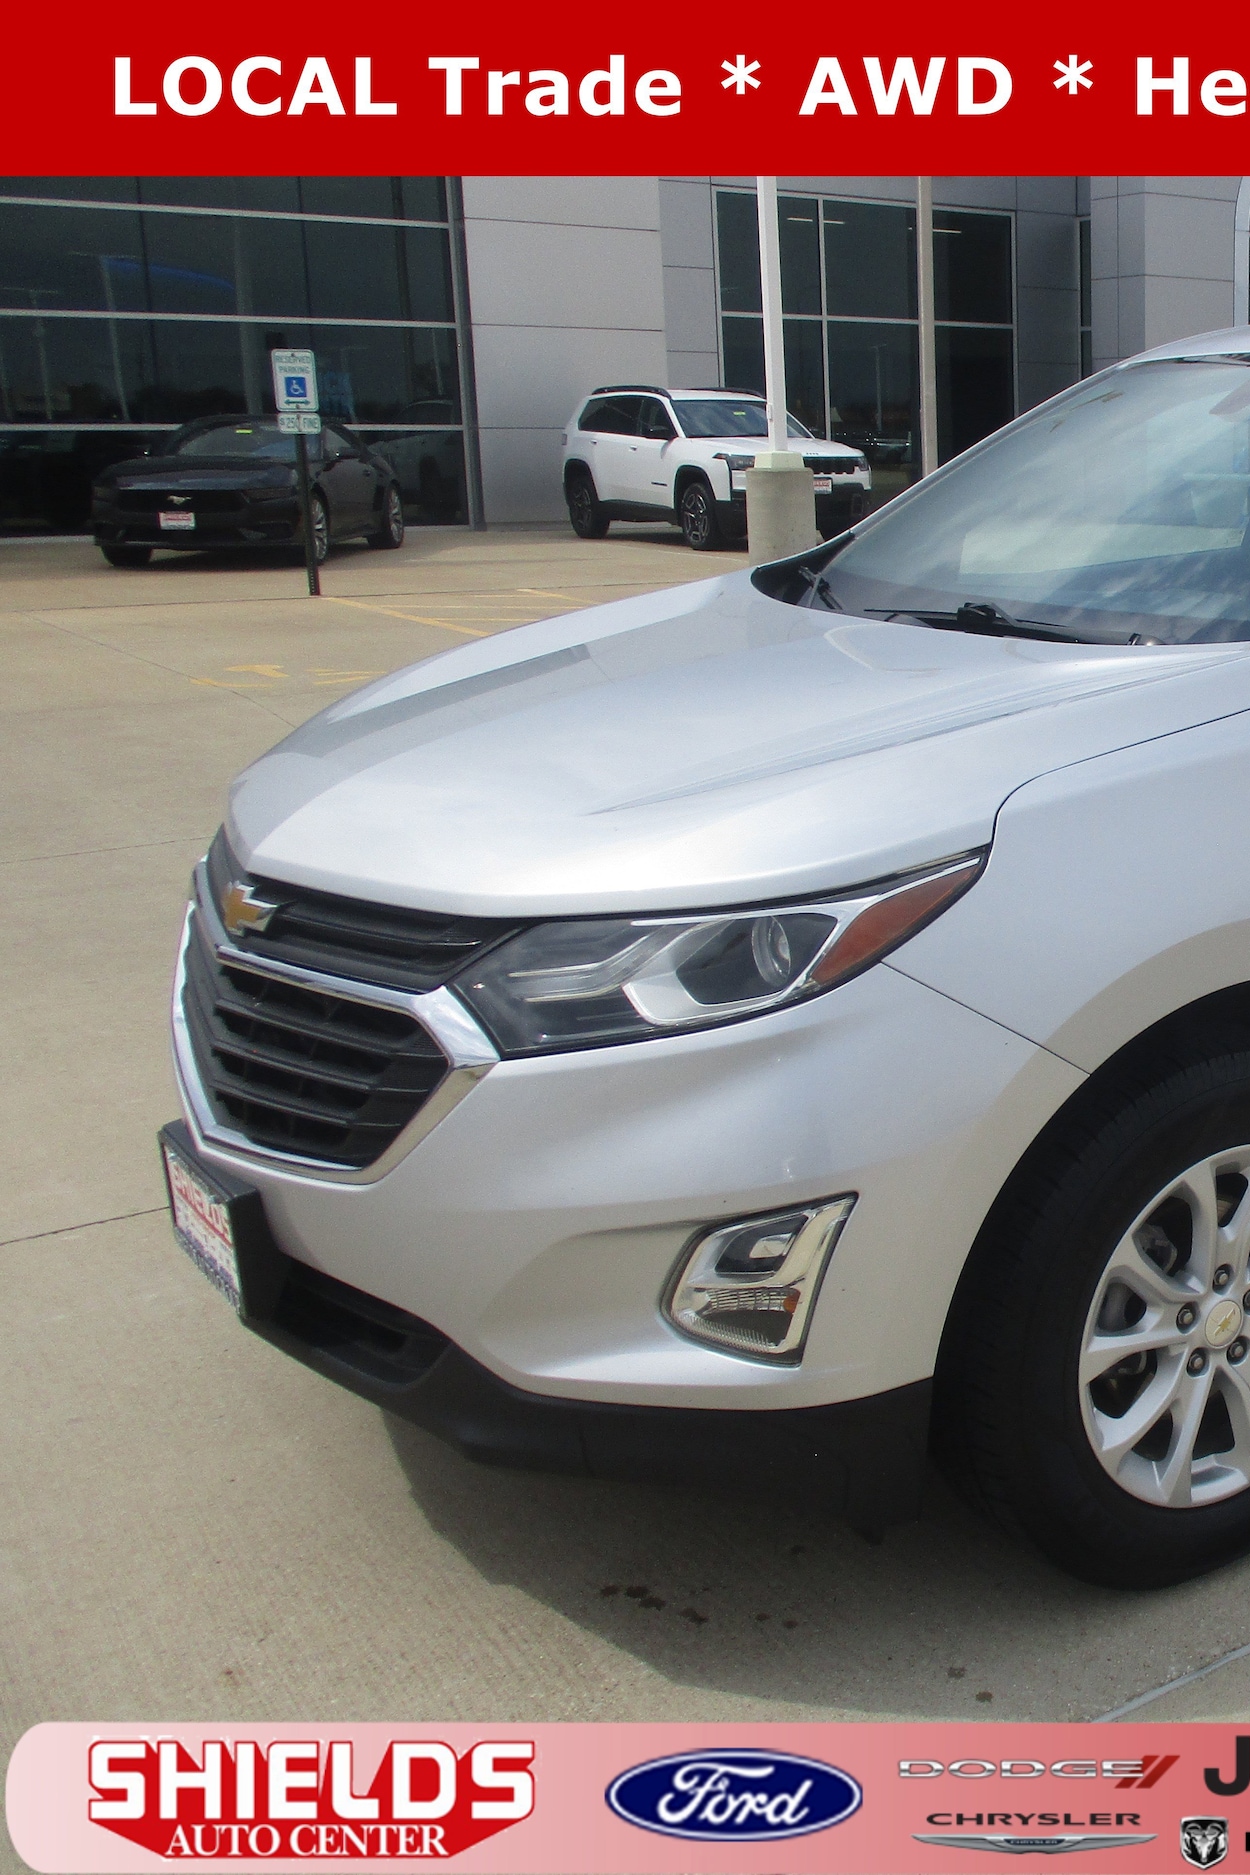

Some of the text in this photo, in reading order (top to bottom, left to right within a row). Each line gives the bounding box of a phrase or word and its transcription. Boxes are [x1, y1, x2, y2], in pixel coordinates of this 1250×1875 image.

[275, 355, 312, 364] RESERVED
[278, 365, 310, 374] PARKING
[303, 417, 318, 428] FINE
